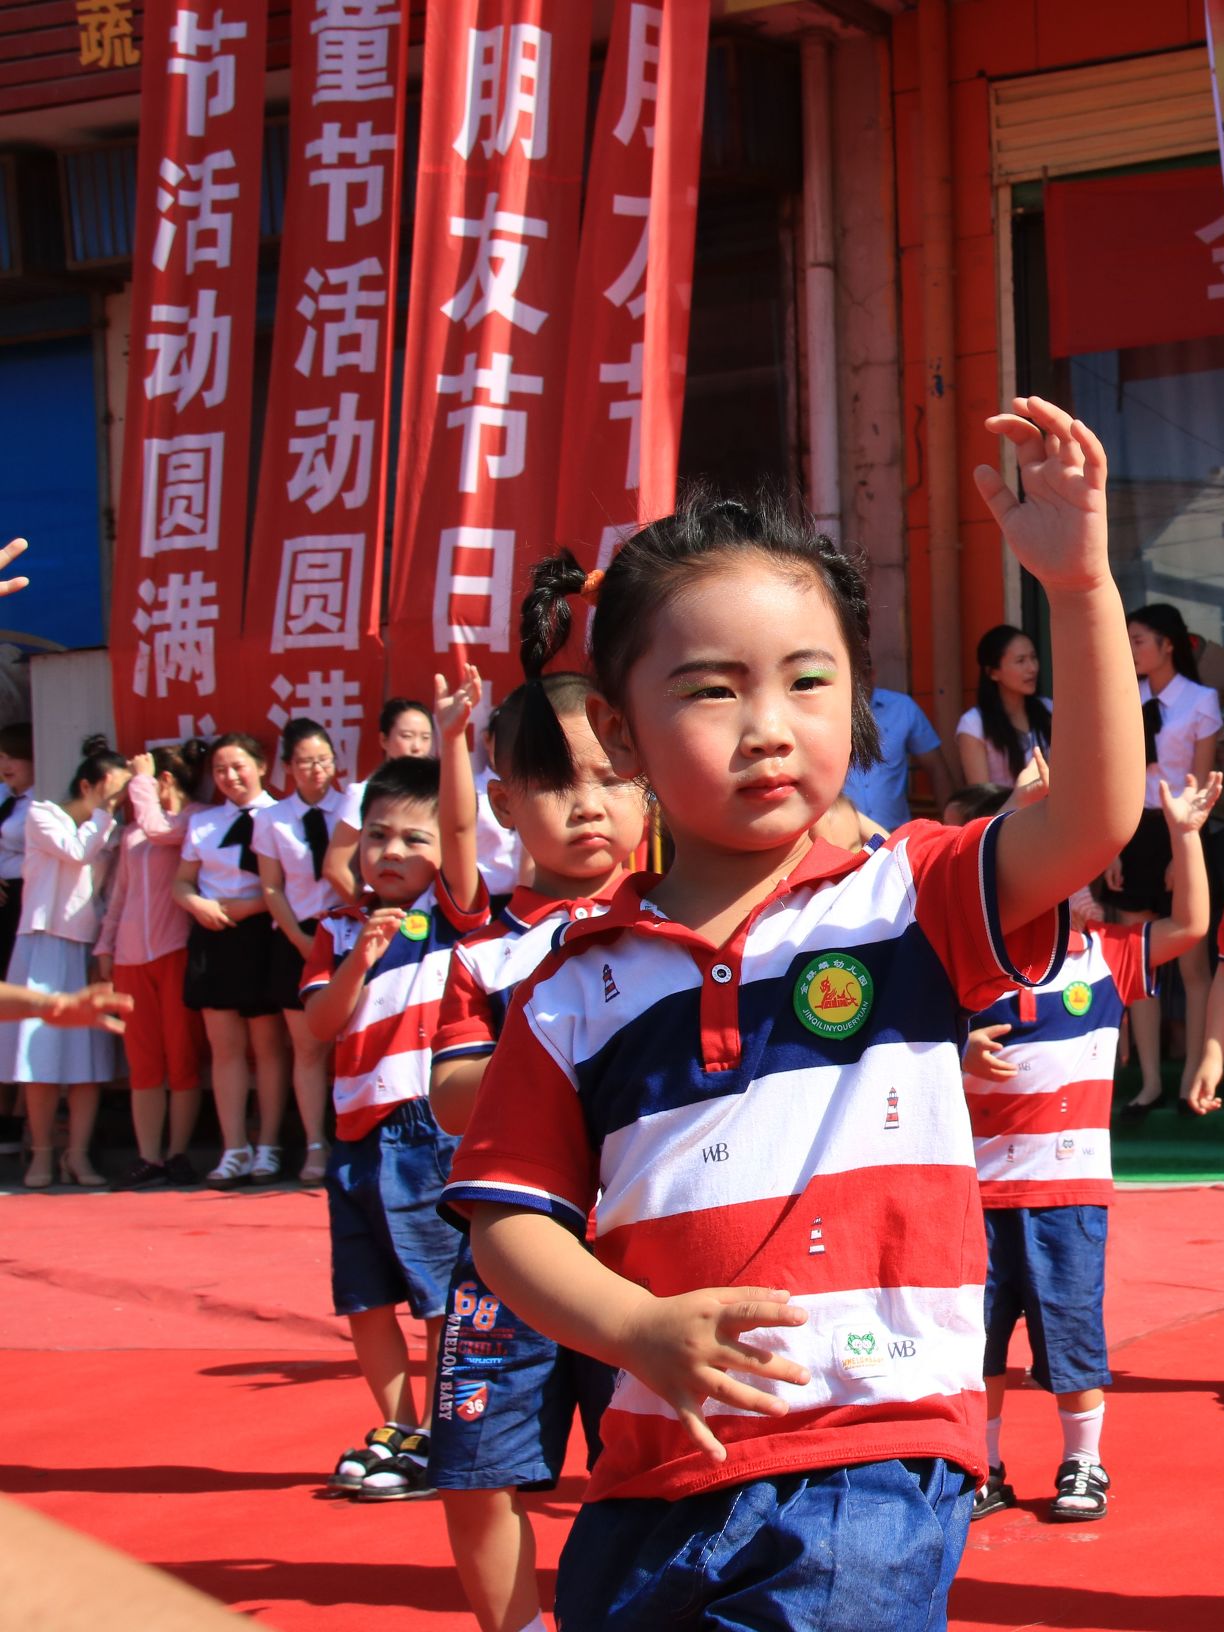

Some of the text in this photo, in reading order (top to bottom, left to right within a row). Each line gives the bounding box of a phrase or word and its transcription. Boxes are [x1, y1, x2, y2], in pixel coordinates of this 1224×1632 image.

[432, 24, 551, 770] 朋友节日
[802, 1001, 869, 1032] JINQILINYOUERYUAN
[701, 1142, 730, 1163] WB
[454, 1281, 500, 1331] 68
[887, 1339, 917, 1360] WB
[438, 1313, 462, 1421] WMELON BABY
[466, 1399, 484, 1414] 36
